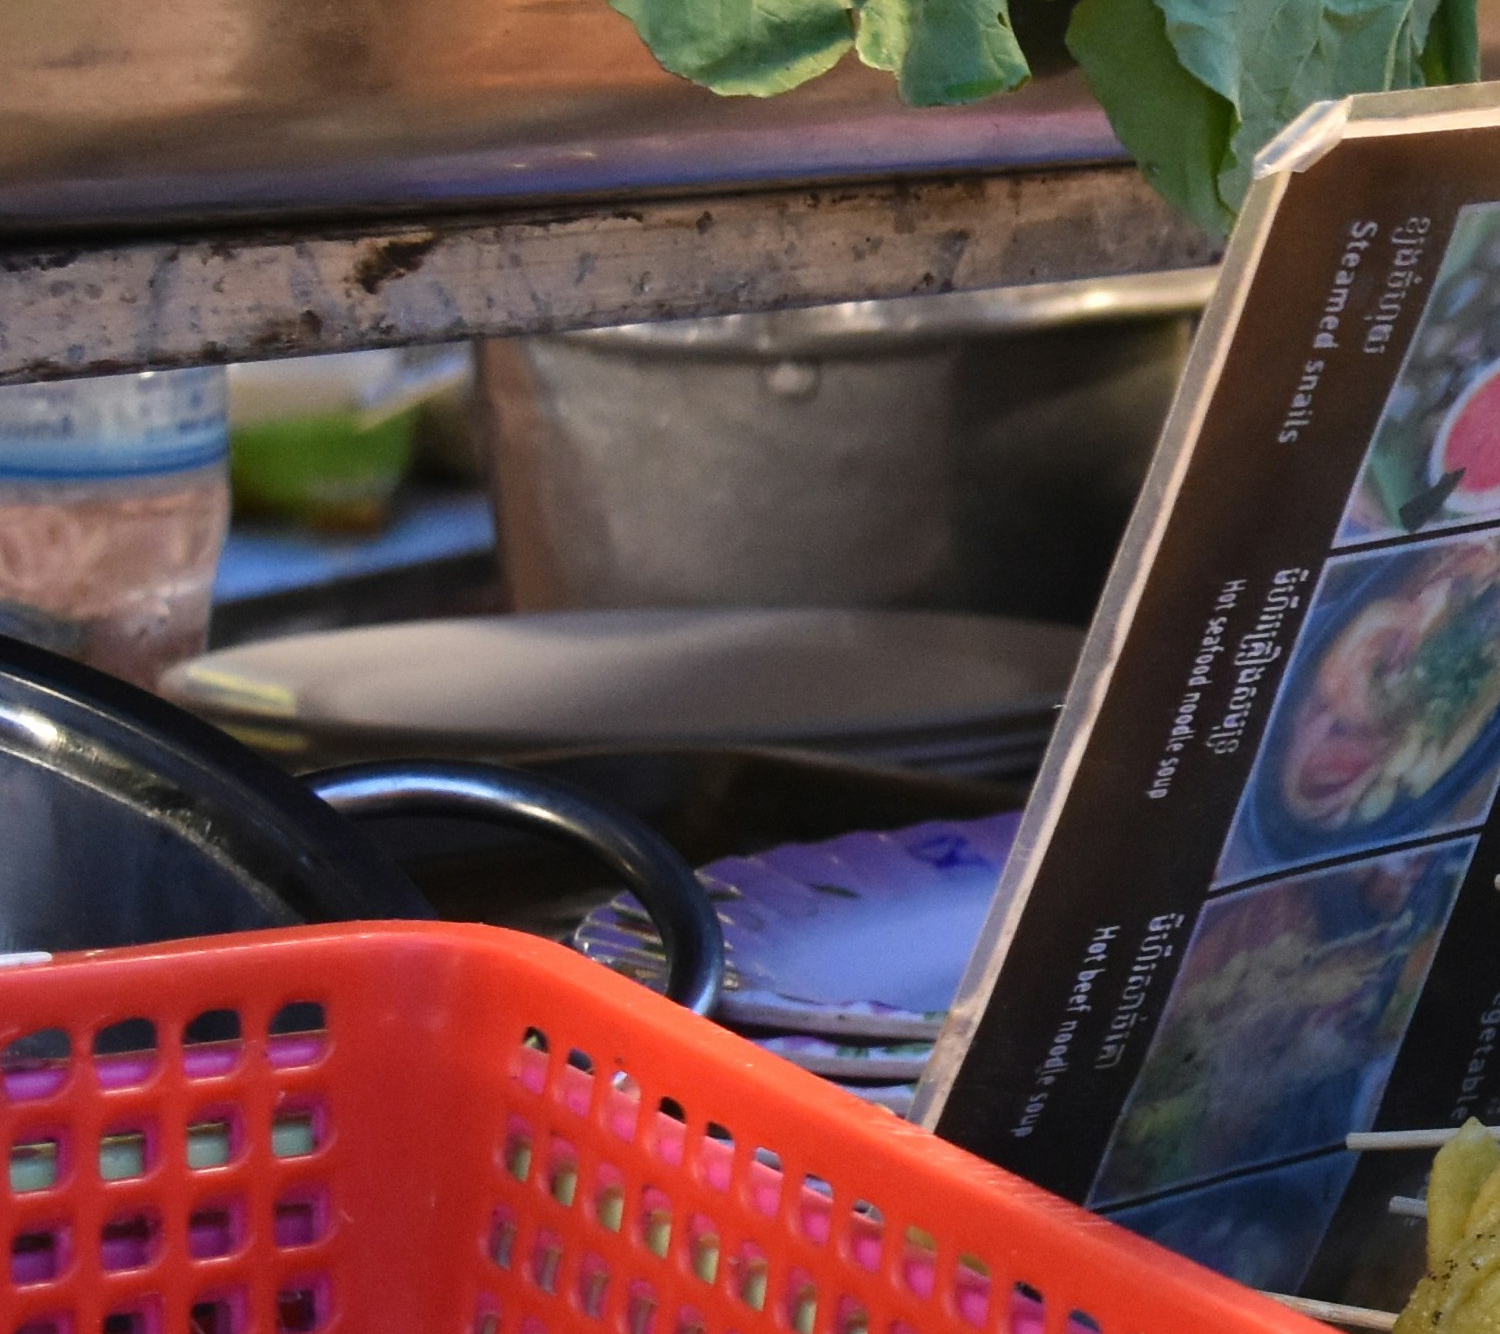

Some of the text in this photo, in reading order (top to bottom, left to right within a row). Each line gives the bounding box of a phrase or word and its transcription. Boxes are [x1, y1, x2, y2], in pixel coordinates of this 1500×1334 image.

[1278, 220, 1378, 444] Steamed snails
[1147, 579, 1246, 799] Hot seafood noodle soup
[1011, 924, 1121, 1139] Hot beef noodle soup
